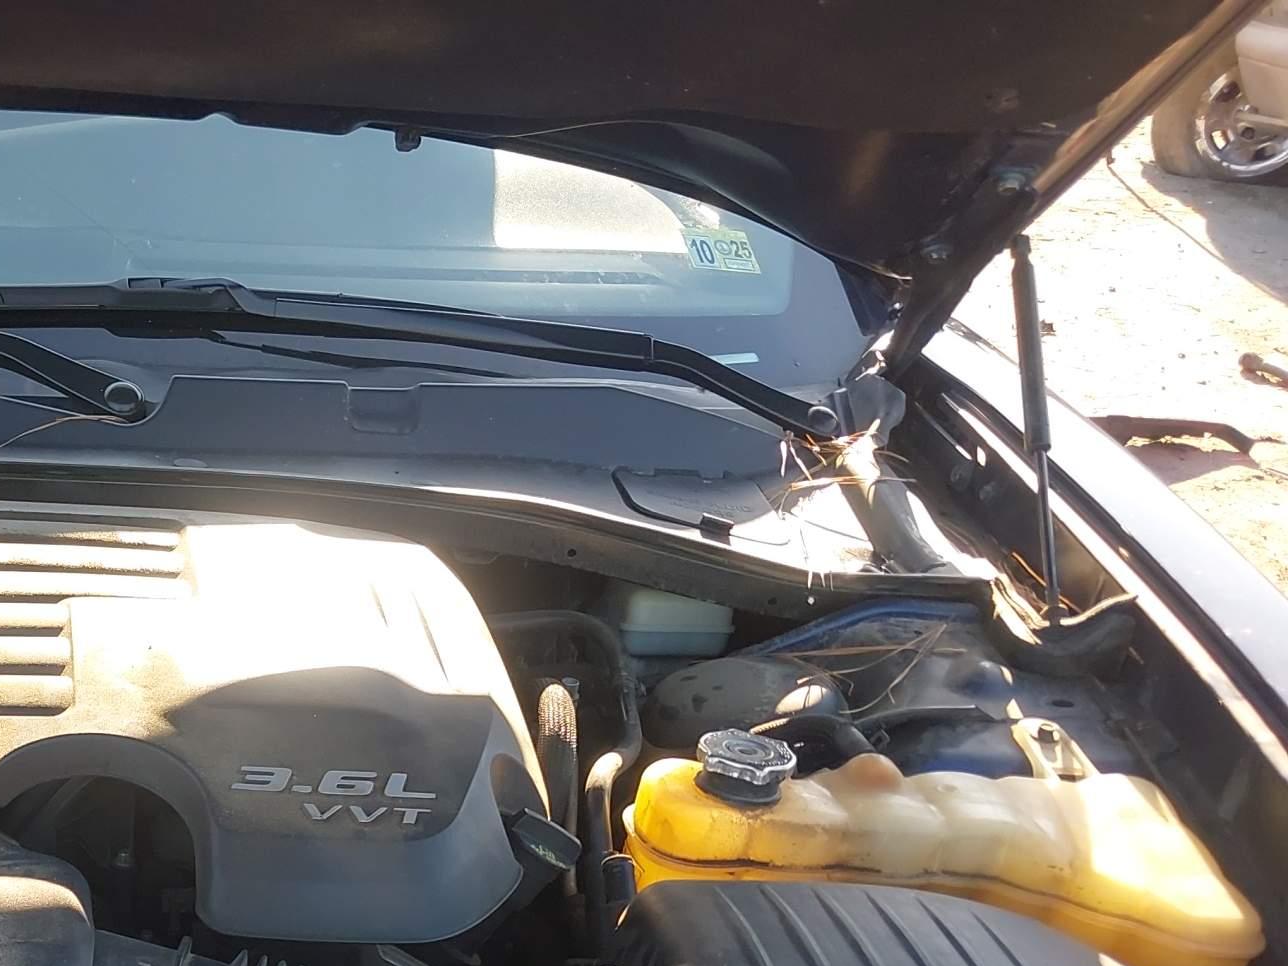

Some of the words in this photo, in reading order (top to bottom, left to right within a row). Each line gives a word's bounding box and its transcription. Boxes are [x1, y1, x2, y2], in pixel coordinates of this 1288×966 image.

[691, 239, 715, 265] 10
[729, 240, 753, 260] 25
[231, 766, 437, 799] 3.6L
[303, 803, 432, 825] VVT
